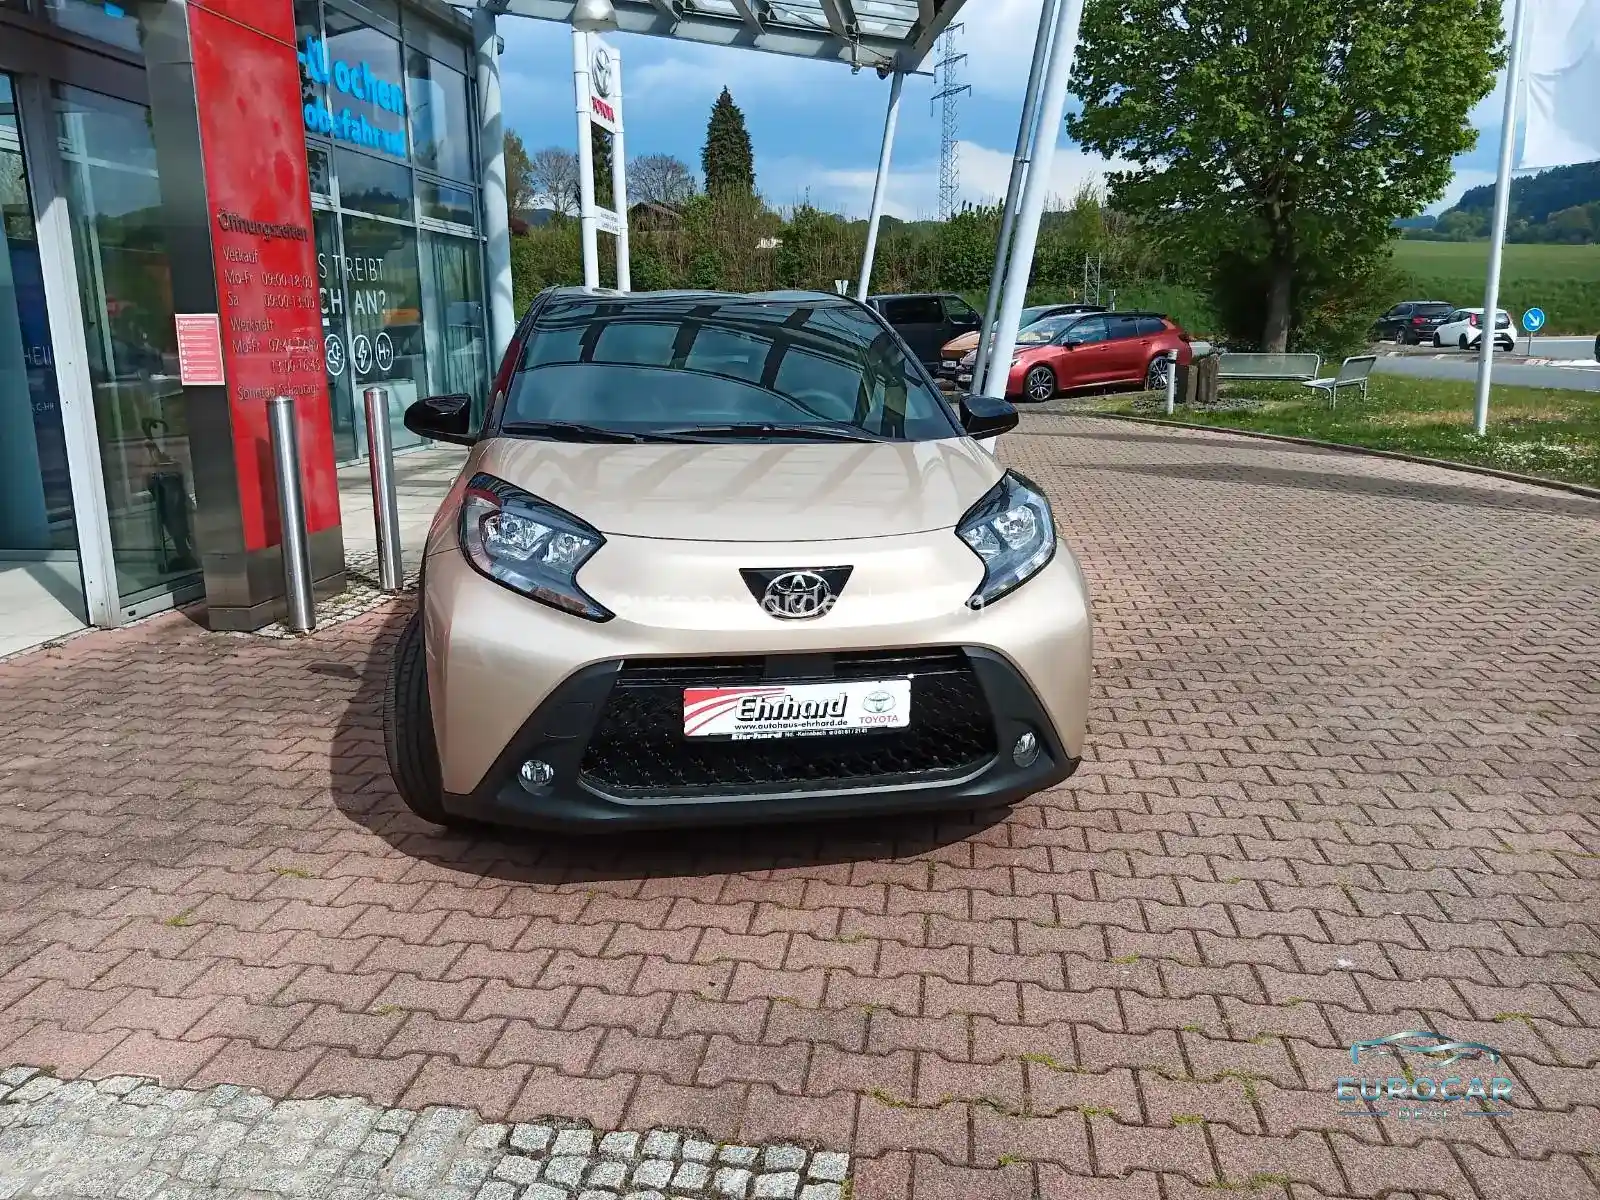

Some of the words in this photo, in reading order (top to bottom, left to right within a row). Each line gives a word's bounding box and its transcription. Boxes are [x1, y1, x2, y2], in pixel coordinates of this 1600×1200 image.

[218, 208, 308, 242] Öffnungszeiten
[222, 245, 258, 263] Verkauf
[224, 269, 254, 286] Mo-Fr
[227, 291, 239, 306] Sa
[355, 289, 386, 315] AN?
[229, 316, 274, 333] Werkstatt
[735, 693, 848, 722] Ehrhard
[734, 719, 848, 730] www.autohaus-ehrhard.de
[859, 714, 899, 725] TOYOTA
